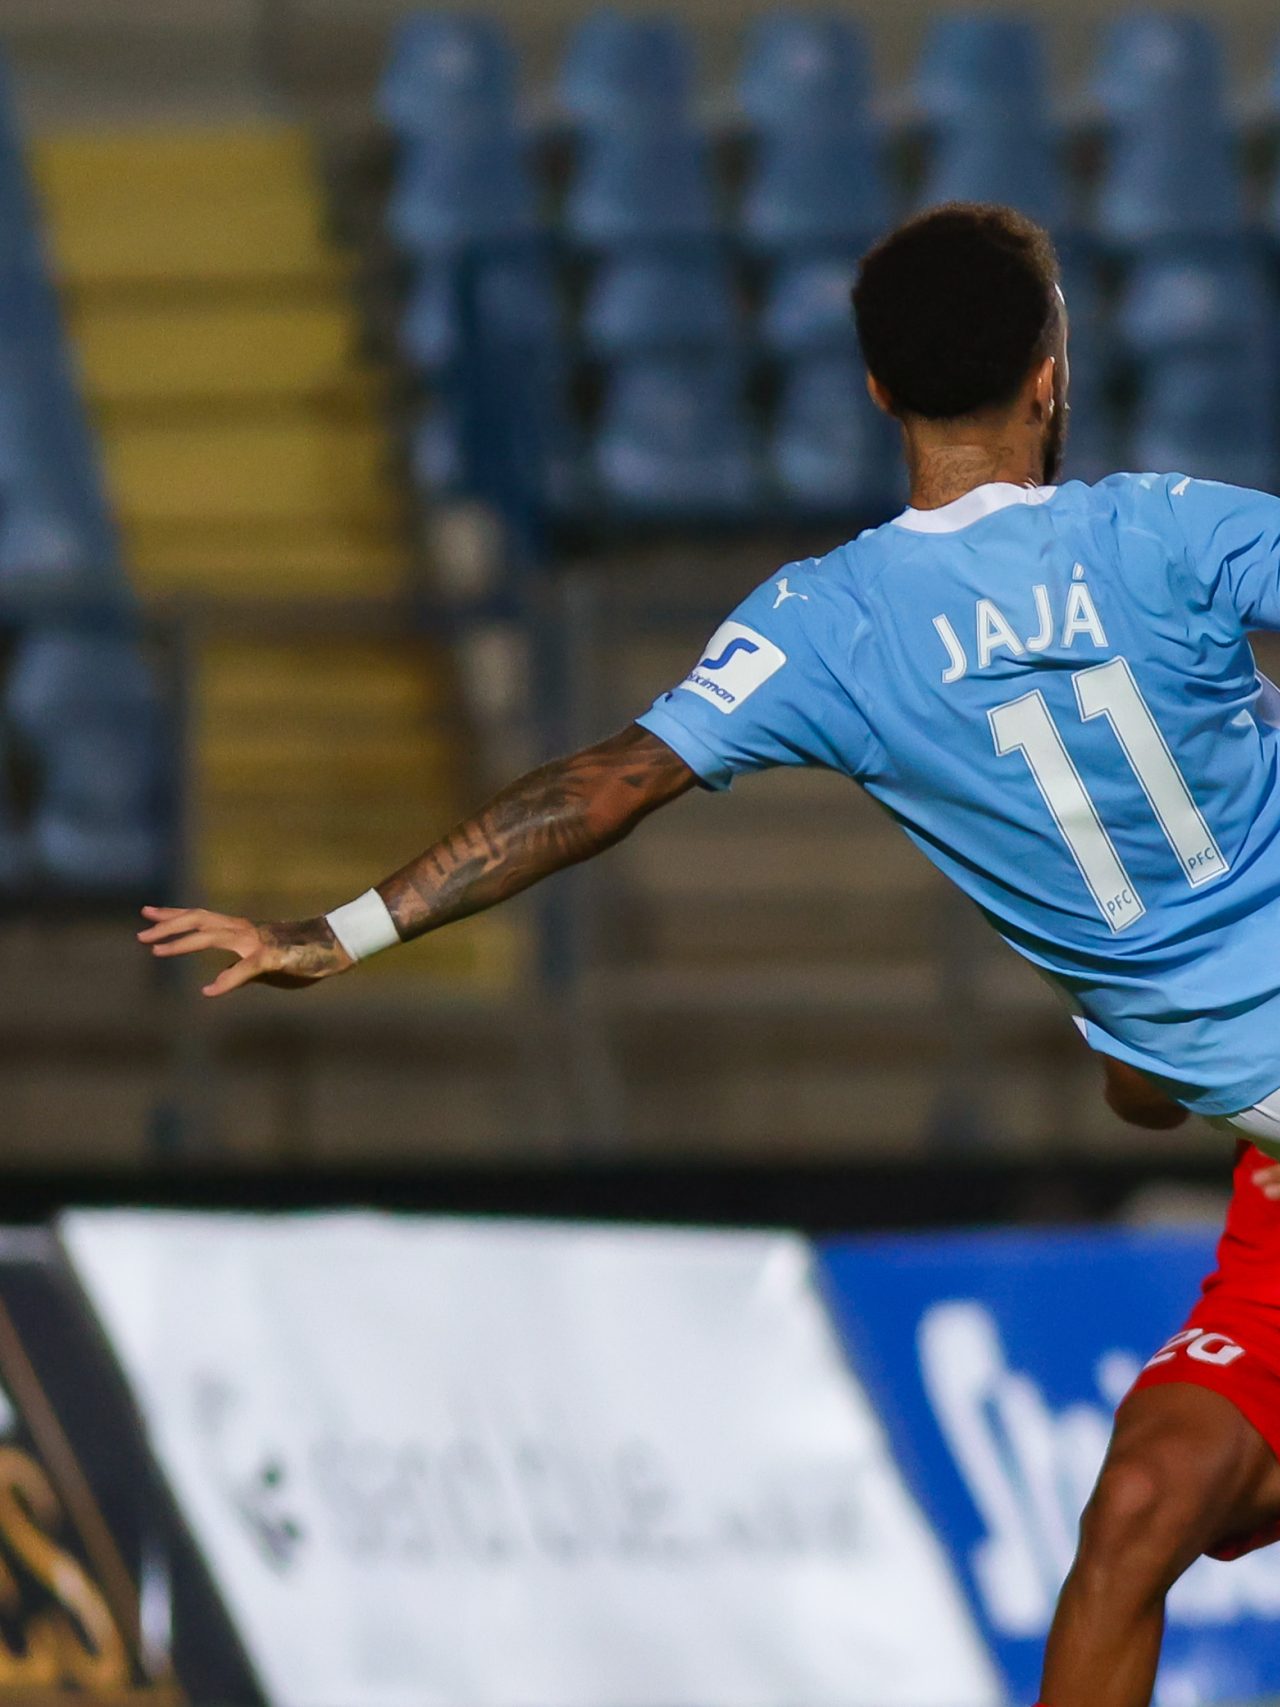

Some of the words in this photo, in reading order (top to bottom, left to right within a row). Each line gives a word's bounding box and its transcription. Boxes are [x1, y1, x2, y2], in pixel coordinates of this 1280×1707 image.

[932, 562, 1109, 684] JAJÁ
[986, 655, 1230, 934] 11
[1187, 847, 1215, 870] PFC
[1106, 889, 1132, 917] PFC
